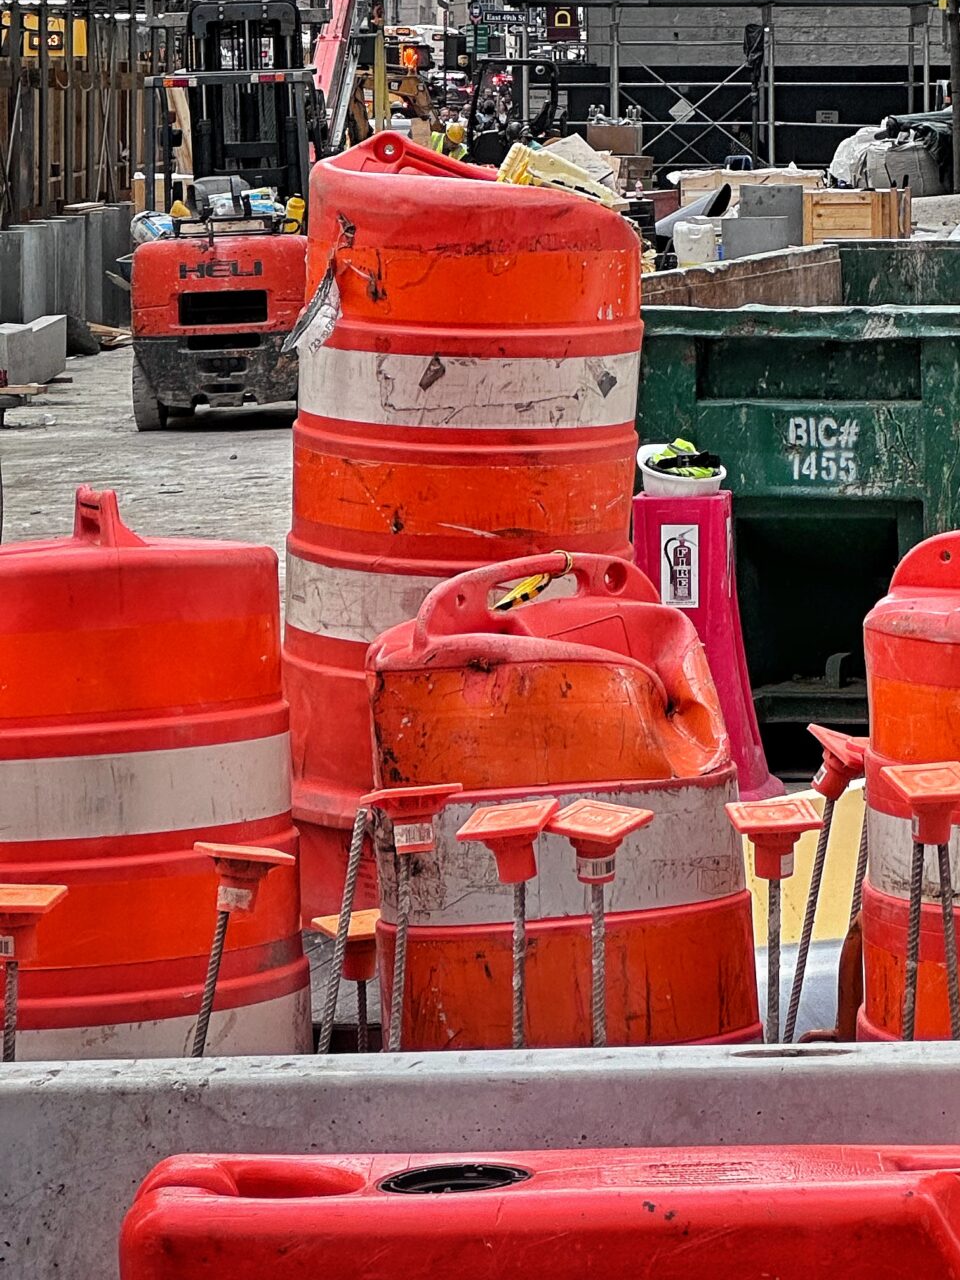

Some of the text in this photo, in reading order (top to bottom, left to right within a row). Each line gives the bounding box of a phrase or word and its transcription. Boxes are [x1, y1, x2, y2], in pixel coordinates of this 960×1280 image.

[486, 13, 501, 21] East
[179, 260, 263, 279] HELI
[788, 416, 860, 447] BIC#
[788, 449, 858, 482] 1455
[676, 547, 689, 588] FIRE
